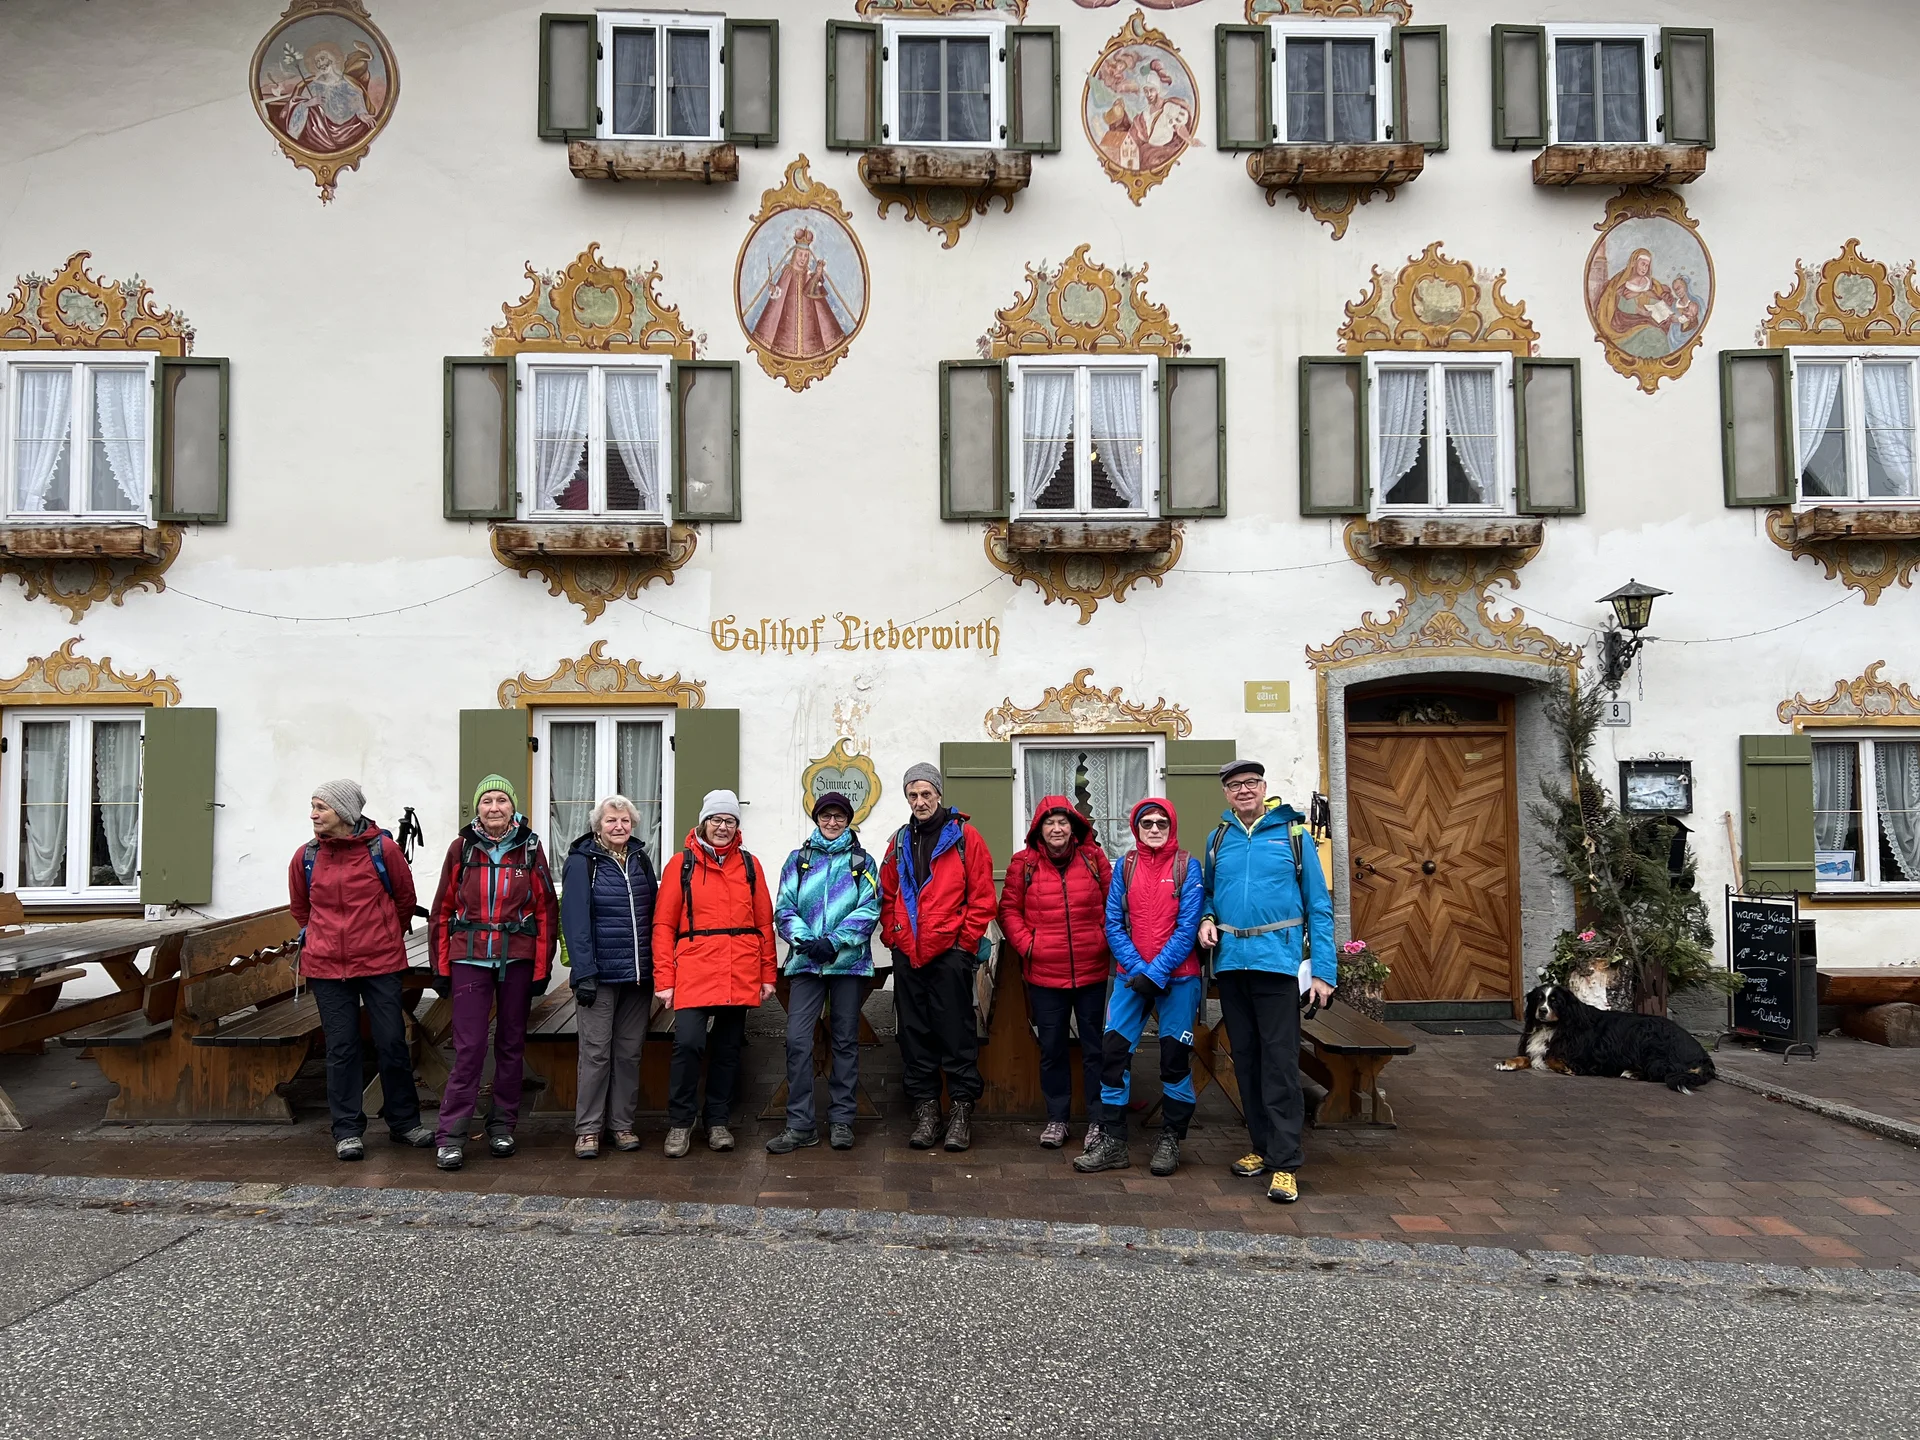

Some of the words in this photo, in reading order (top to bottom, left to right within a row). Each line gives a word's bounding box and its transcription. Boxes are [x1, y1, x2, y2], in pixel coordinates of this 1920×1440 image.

[833, 612, 1000, 657] Lieberwirth
[1256, 691, 1278, 701] Wirt
[1613, 704, 1619, 717] 8
[816, 775, 851, 791] Zimmer
[853, 779, 864, 791] zu
[1768, 910, 1791, 923] Küche
[1758, 1007, 1791, 1030] Ruhetag
